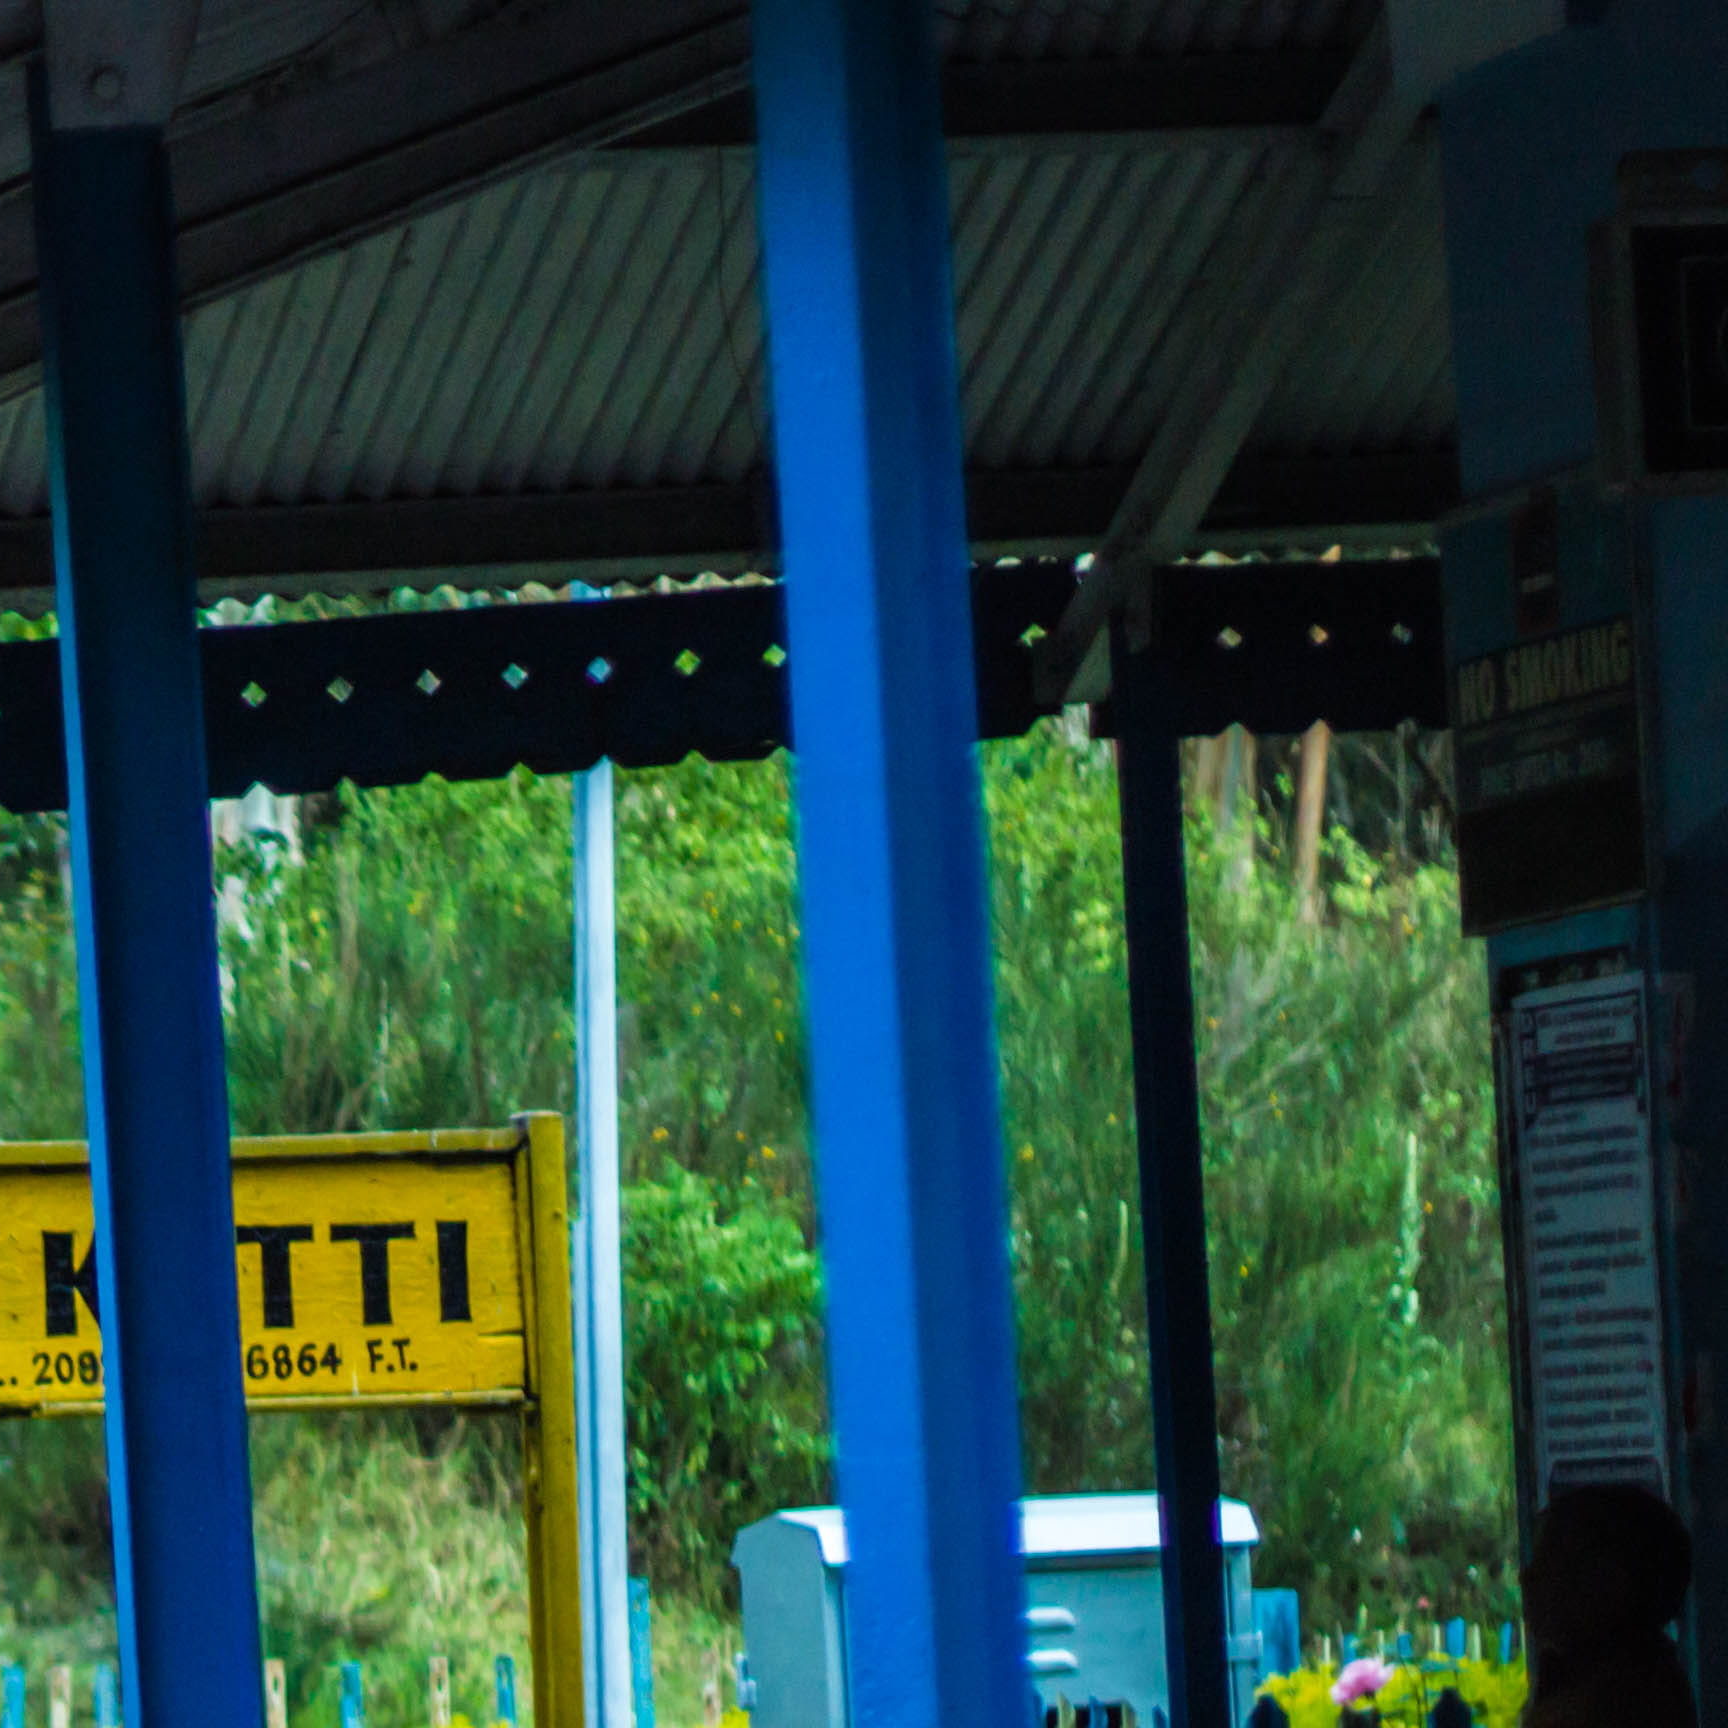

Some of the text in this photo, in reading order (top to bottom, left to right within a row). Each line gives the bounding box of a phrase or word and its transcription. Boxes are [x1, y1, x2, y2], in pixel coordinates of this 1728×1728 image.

[41, 1219, 472, 1338] KTTI
[246, 1342, 342, 1380] 6864
[366, 1338, 419, 1374] F.T.
